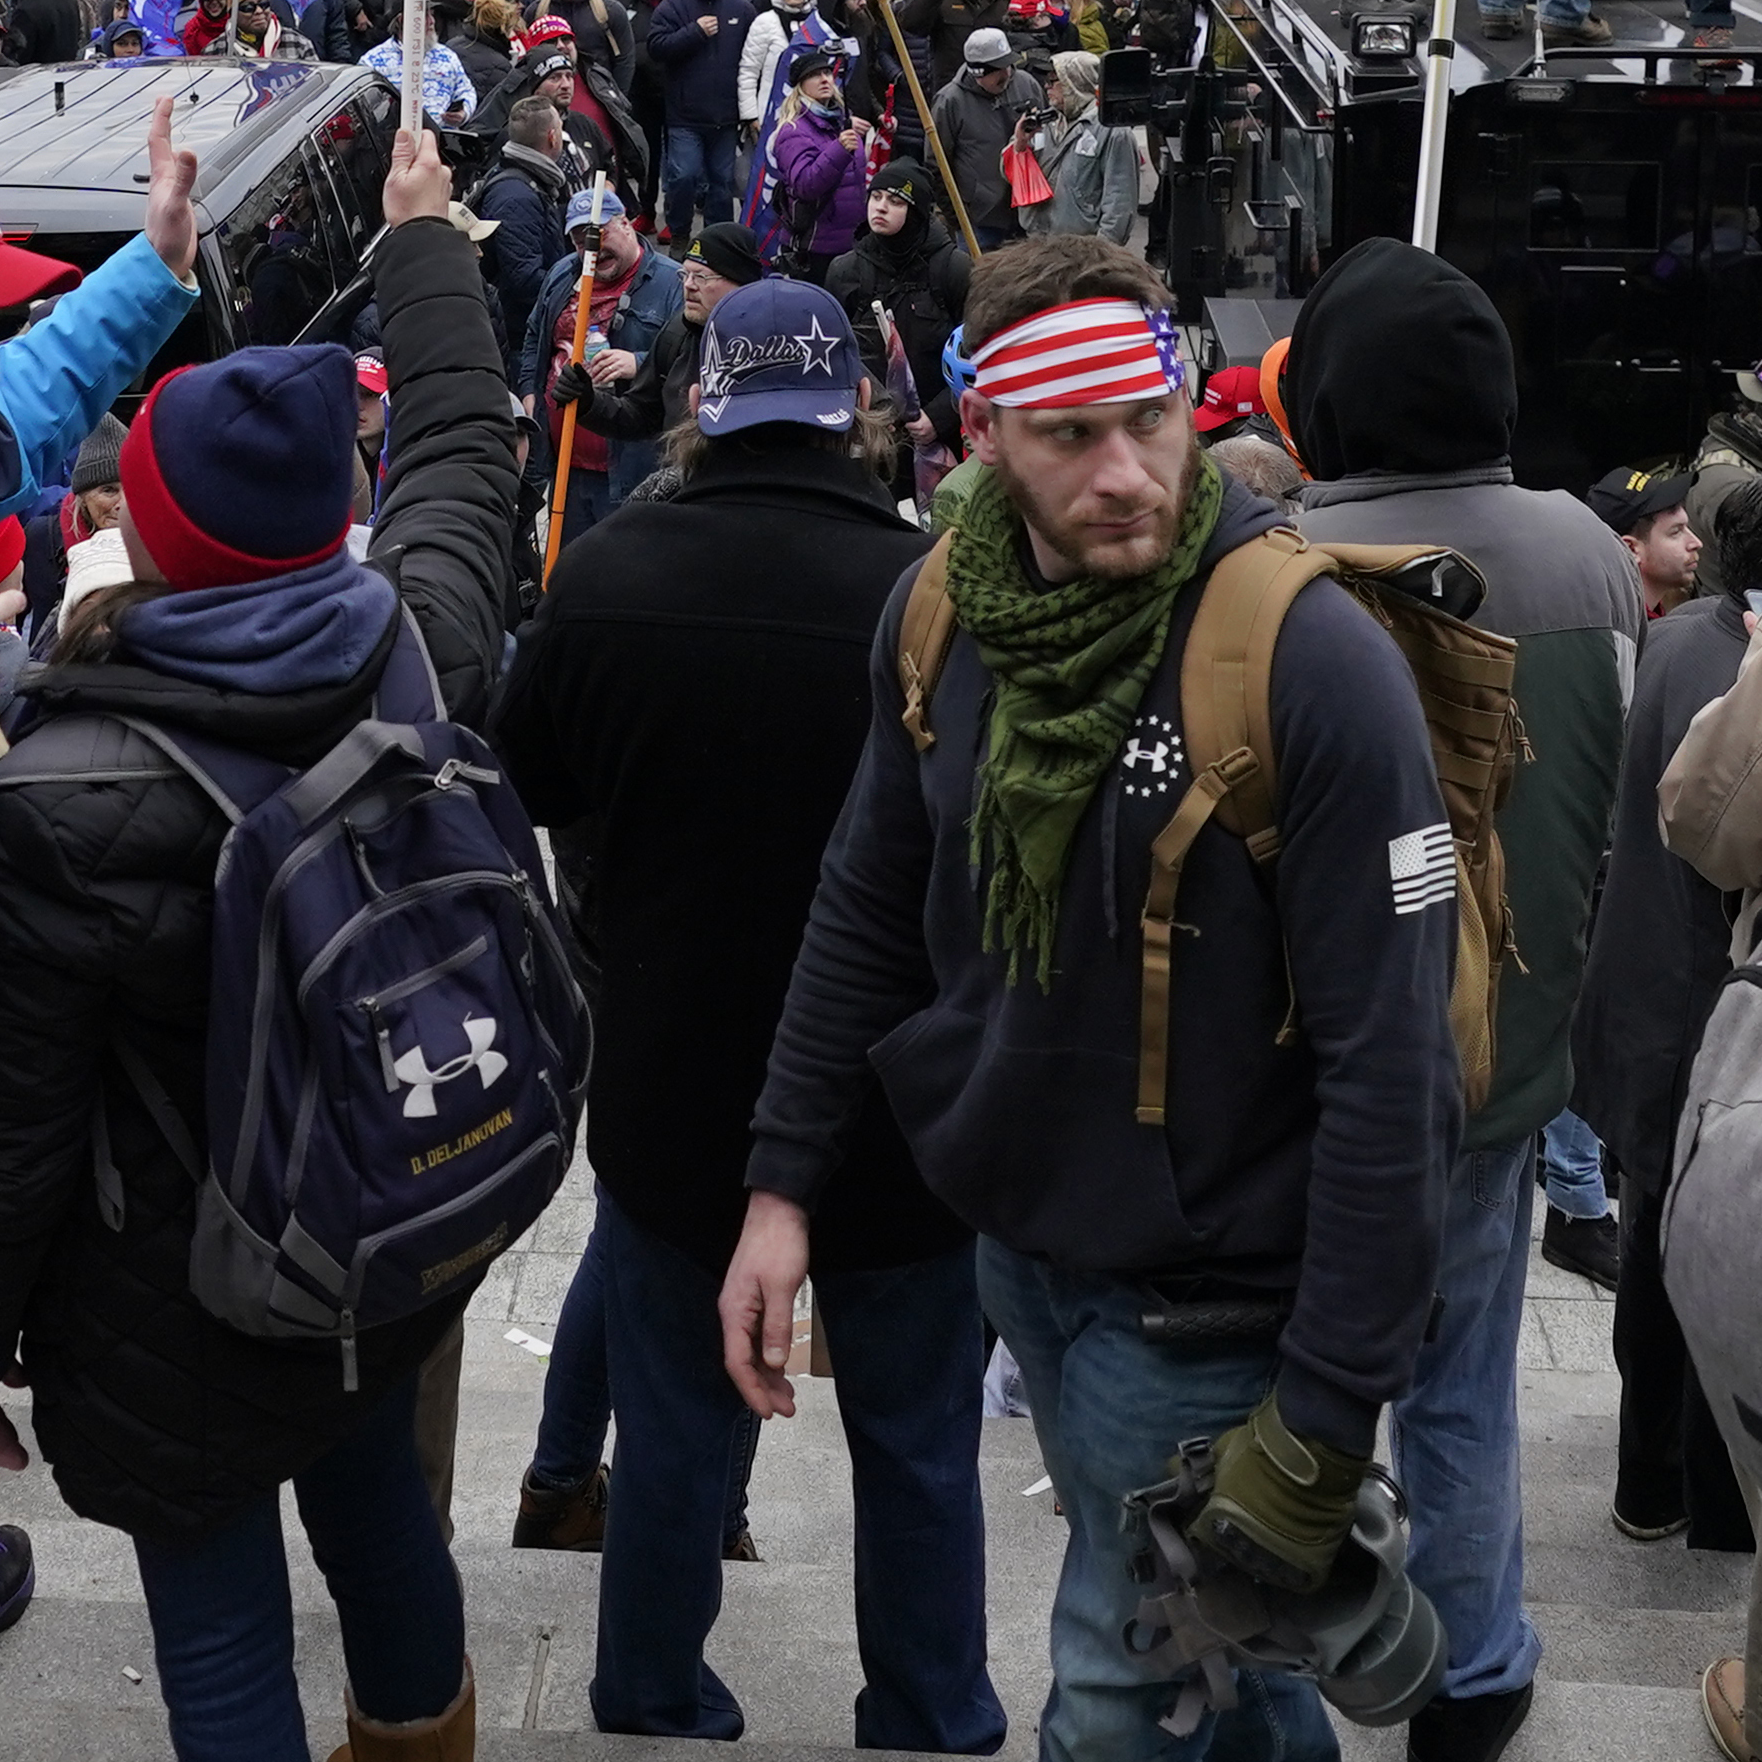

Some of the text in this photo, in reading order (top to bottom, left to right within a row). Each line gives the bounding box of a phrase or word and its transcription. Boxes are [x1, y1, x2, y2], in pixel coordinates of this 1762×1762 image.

[724, 334, 808, 368] Dallas
[410, 1107, 514, 1176] D. DELJANOVAN
